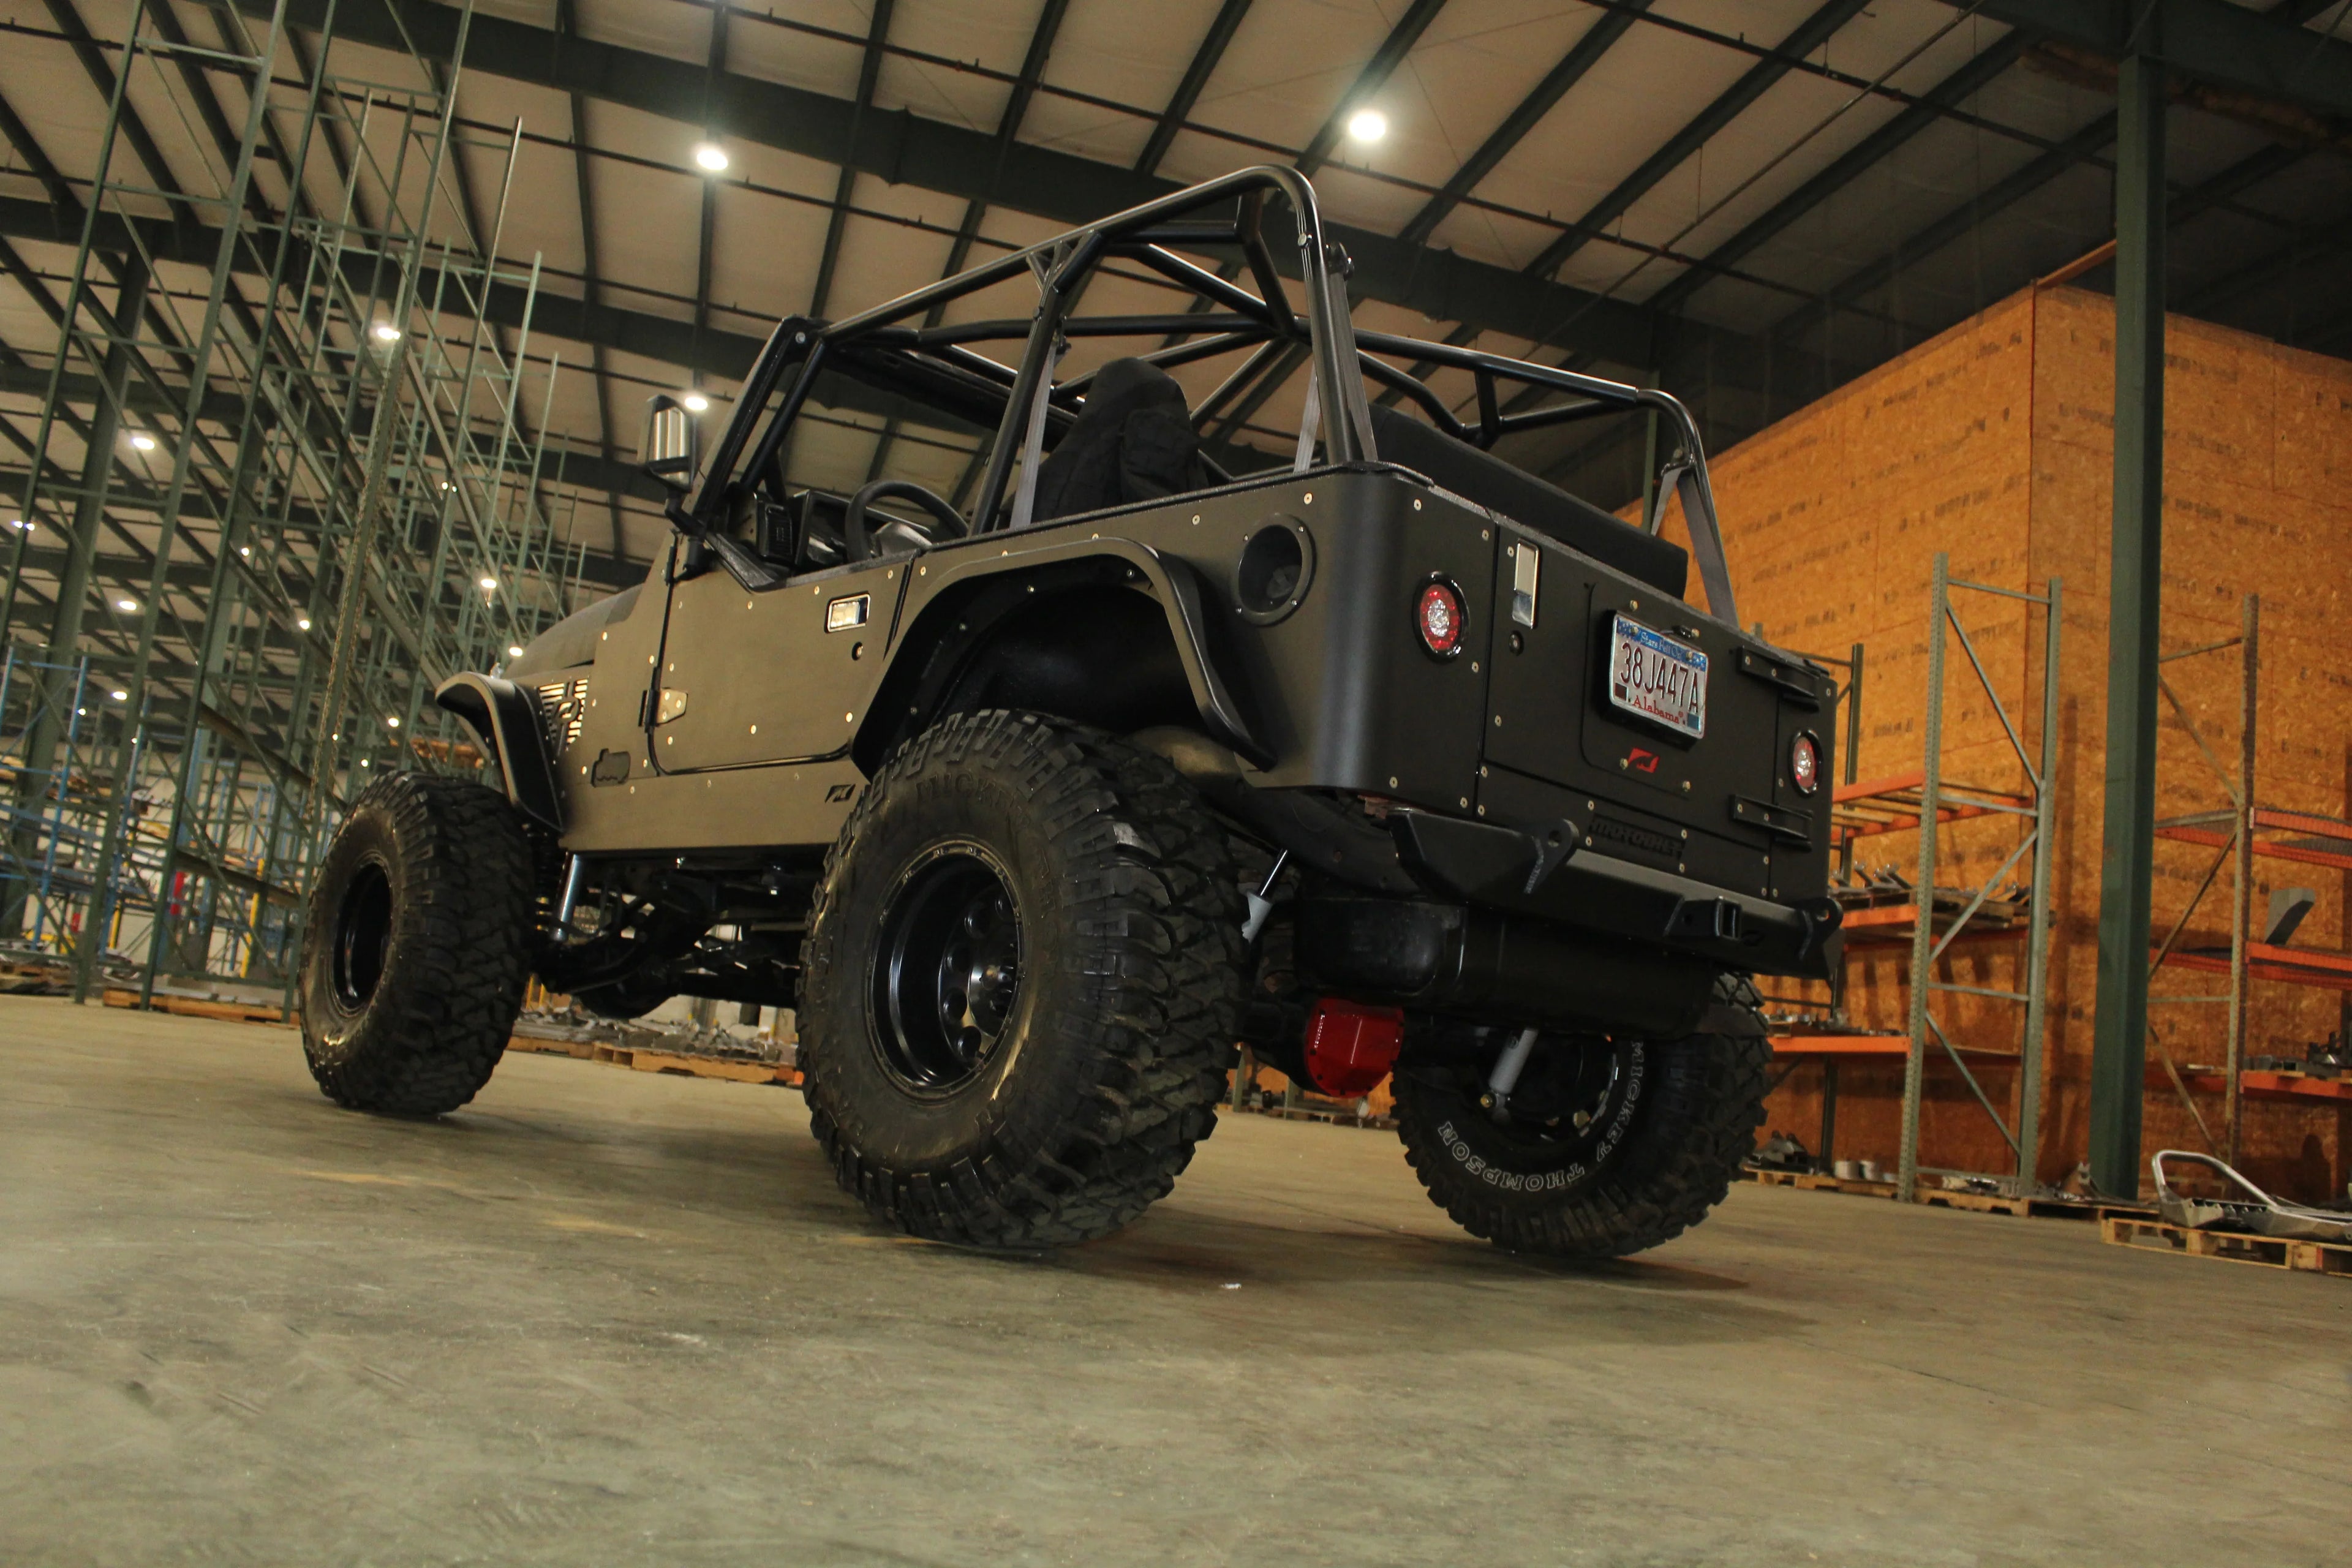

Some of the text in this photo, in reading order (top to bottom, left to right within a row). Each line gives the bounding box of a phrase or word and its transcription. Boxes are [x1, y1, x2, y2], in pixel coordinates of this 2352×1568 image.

[1619, 642, 1698, 714] 38J447A
[1632, 695, 1679, 725] Alabama
[1437, 1040, 1645, 1192] MICKEY THOMPSON
